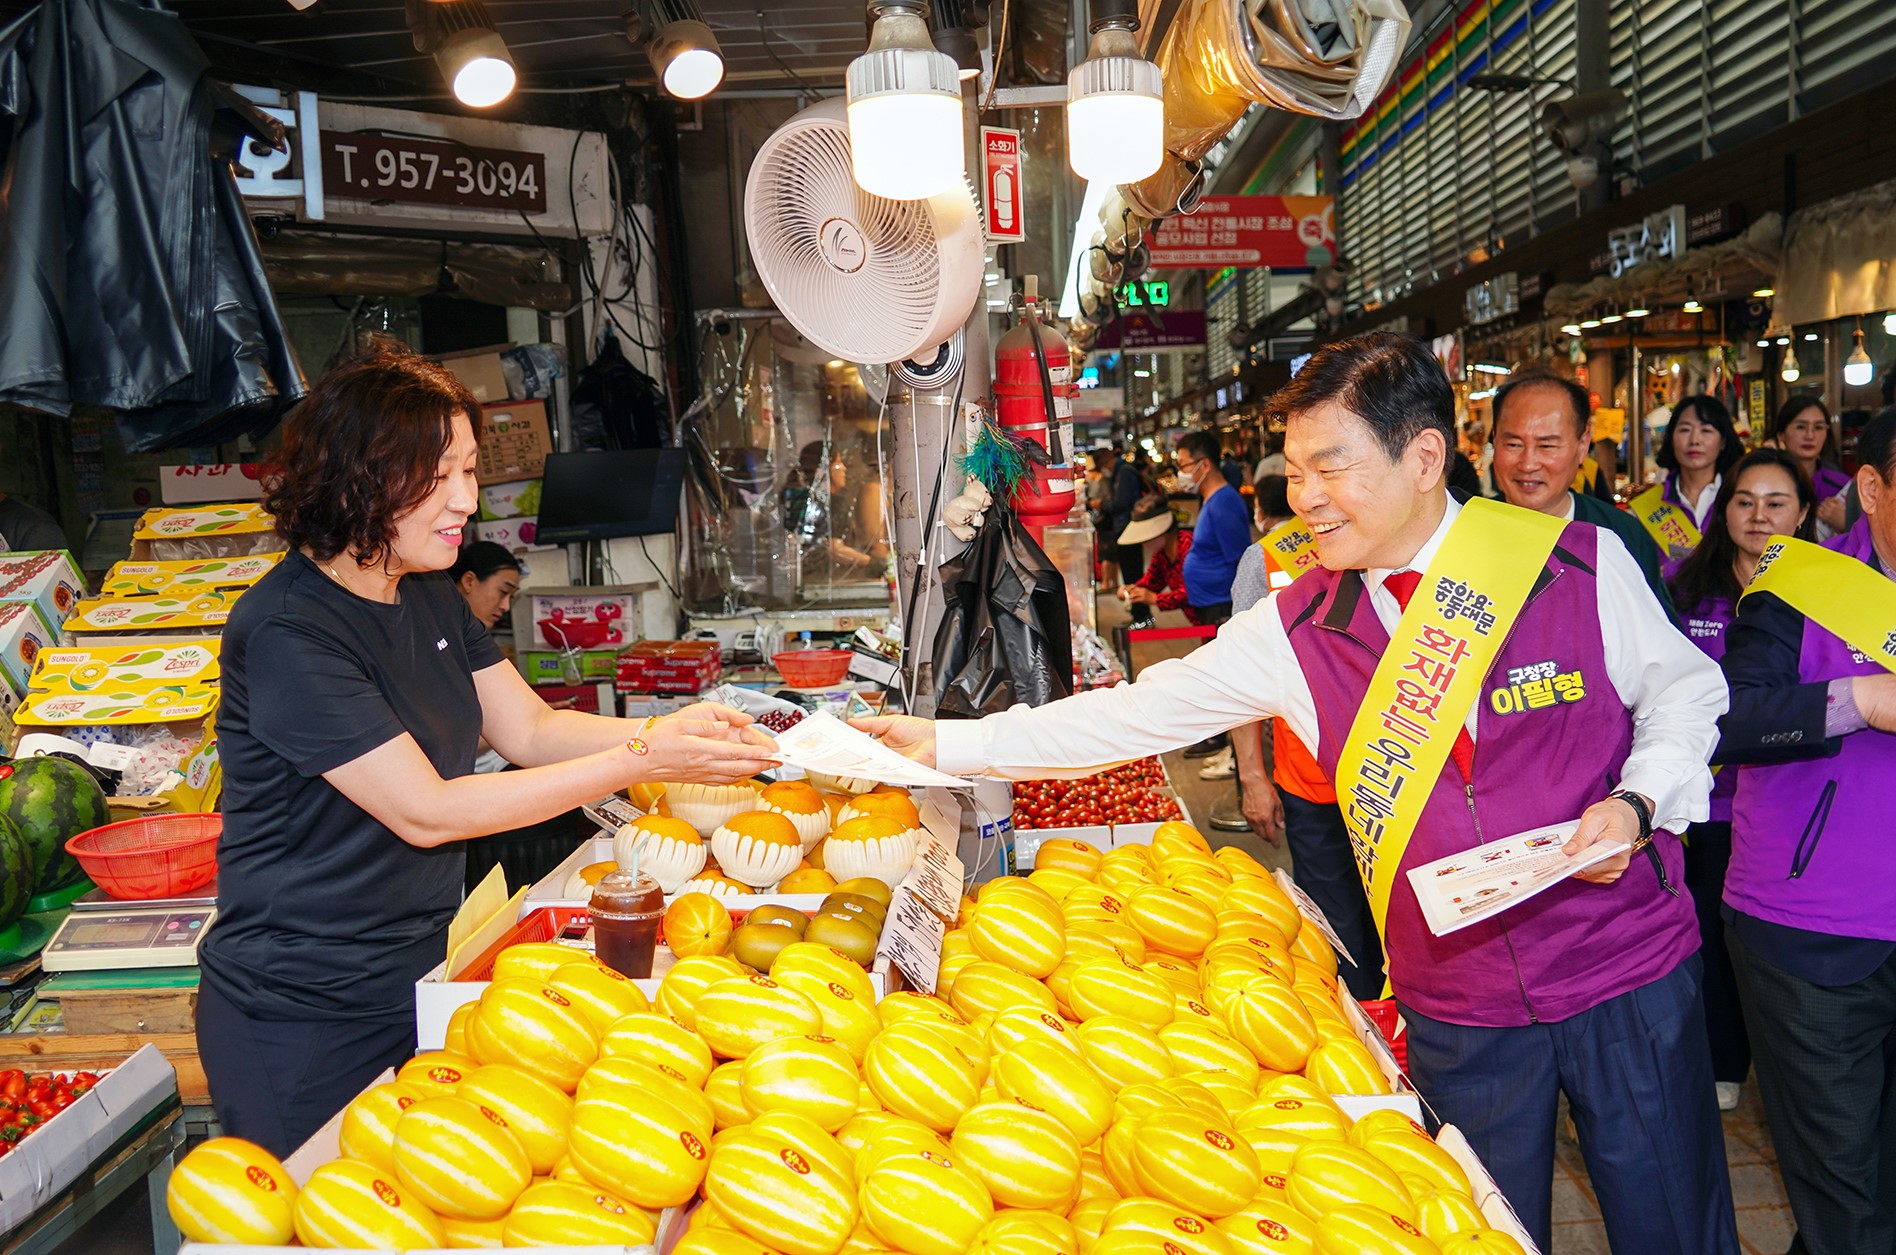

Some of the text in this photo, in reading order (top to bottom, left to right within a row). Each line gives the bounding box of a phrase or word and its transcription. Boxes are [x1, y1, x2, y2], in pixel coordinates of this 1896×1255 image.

[989, 140, 1015, 154] 소화기
[335, 144, 540, 200] T.957-3094
[162, 517, 196, 529] Zespri
[121, 566, 154, 575] SUNGOLD
[227, 564, 262, 577] Zespri
[1433, 576, 1494, 613] 좋아요
[96, 608, 132, 619] Zespri
[1440, 599, 1497, 636] 동대문
[1704, 620, 1724, 630] Zero
[50, 655, 86, 663] SUNGOLD
[164, 656, 201, 671] Zespri
[663, 656, 700, 667] Supreme
[1508, 661, 1558, 685] 구청장
[1491, 669, 1587, 715] 이필형
[45, 700, 86, 713] Zespri
[165, 706, 200, 715] SUNGOLD
[192, 760, 205, 787] Zespri
